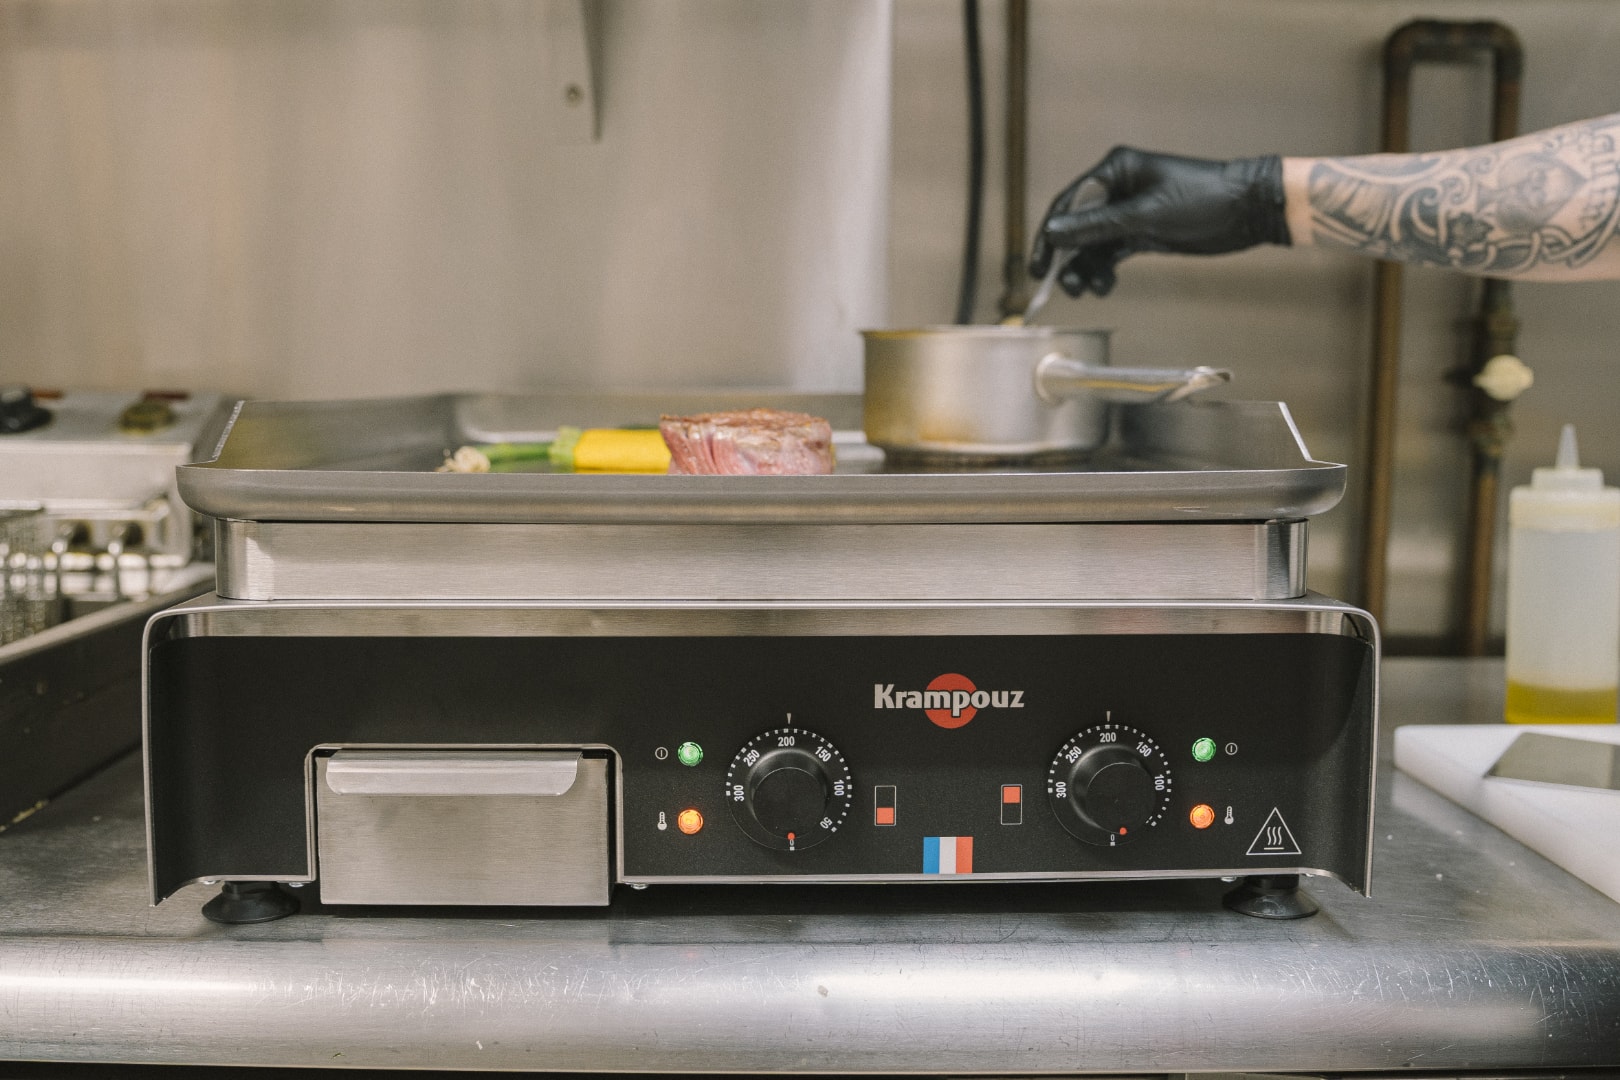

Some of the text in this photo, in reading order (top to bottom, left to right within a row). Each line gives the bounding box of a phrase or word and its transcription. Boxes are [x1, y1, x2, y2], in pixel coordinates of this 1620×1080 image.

[874, 683, 1025, 717] Krampouz
[777, 736, 795, 747] 200
[1100, 732, 1117, 743] 200
[815, 746, 832, 762] 150
[1065, 746, 1082, 763] 250
[1135, 741, 1152, 757] 150
[743, 749, 760, 767] 250
[833, 779, 844, 796] 100
[1056, 781, 1067, 798] 300
[1154, 774, 1165, 791] 100
[733, 784, 744, 802] 300
[820, 816, 833, 829] 50
